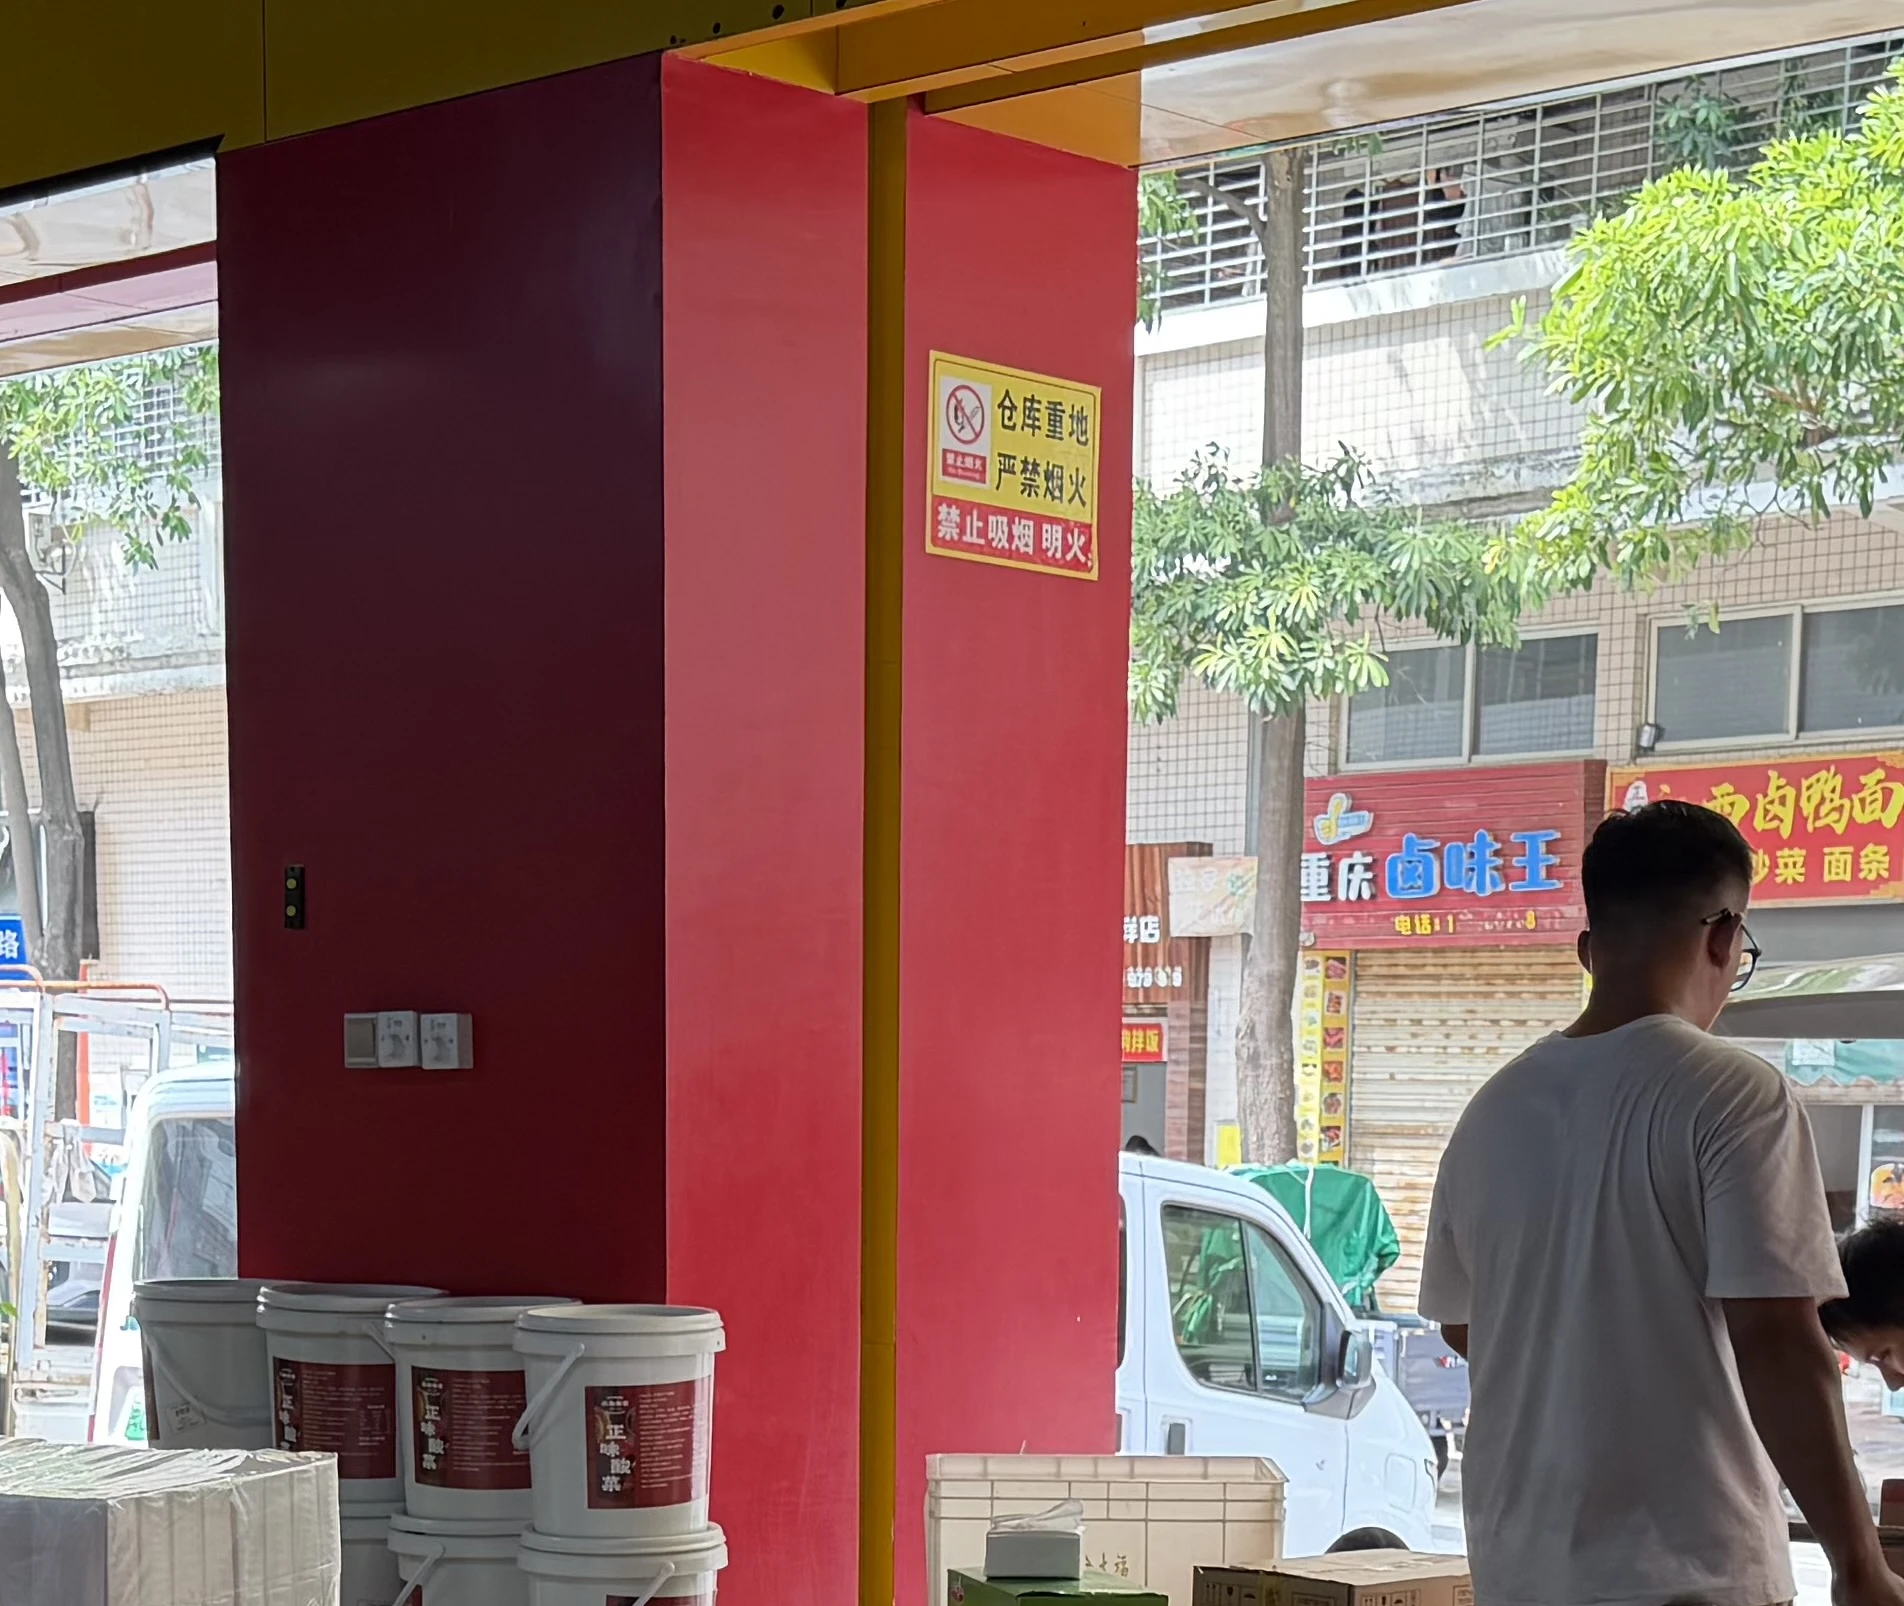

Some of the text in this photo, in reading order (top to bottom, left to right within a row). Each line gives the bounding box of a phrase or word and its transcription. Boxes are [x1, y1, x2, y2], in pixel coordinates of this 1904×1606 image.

[996, 388, 1089, 447] 仓库重地
[996, 452, 1087, 508] 严禁烟火
[936, 503, 1087, 564] 禁止吸烟 明火
[1300, 851, 1373, 901] 重庆
[1385, 829, 1564, 898] 卤味王
[1823, 843, 1890, 882] 面条
